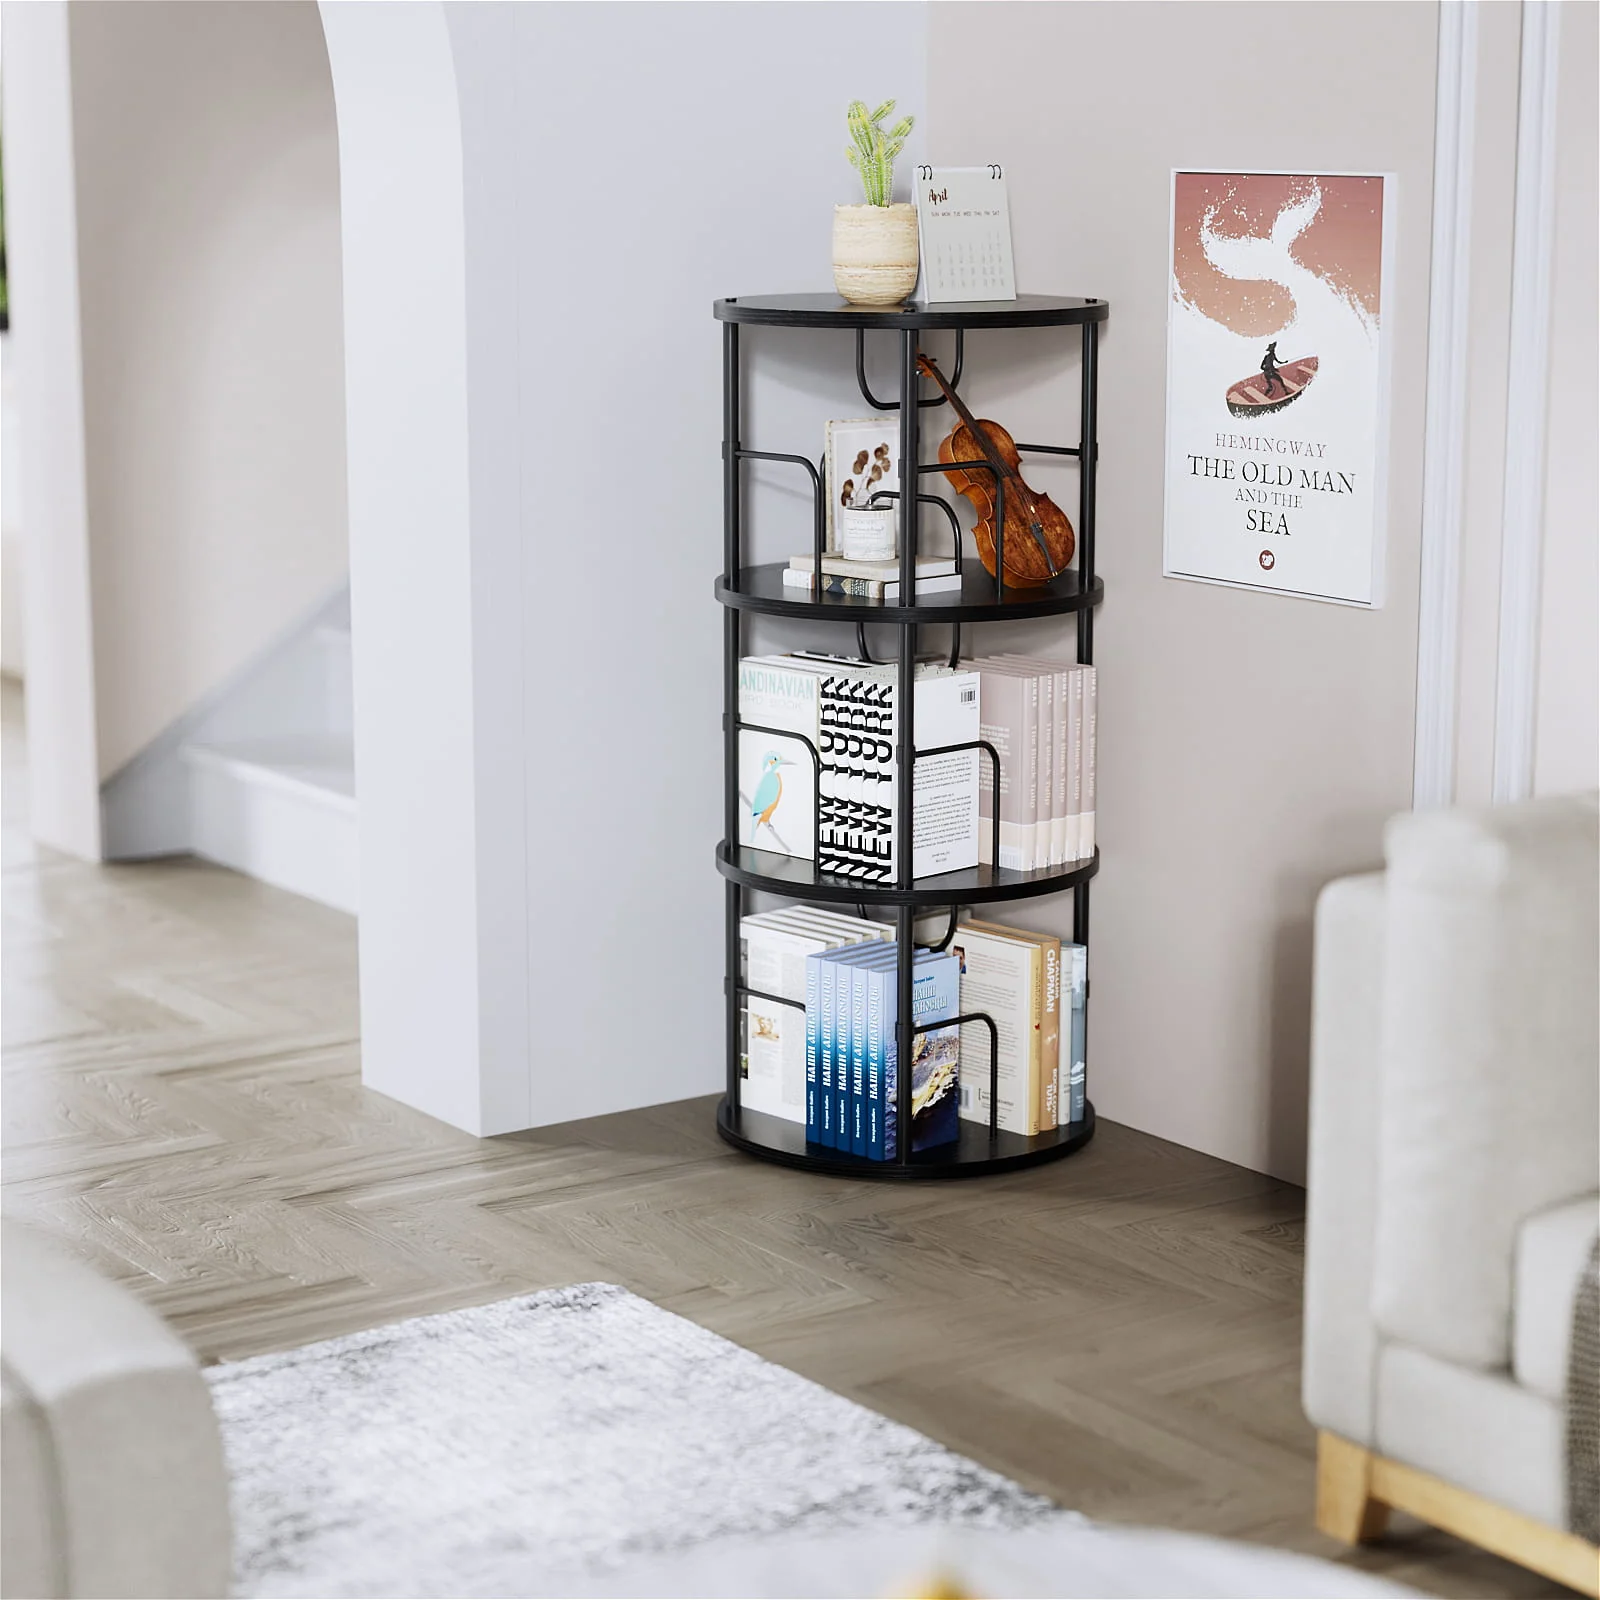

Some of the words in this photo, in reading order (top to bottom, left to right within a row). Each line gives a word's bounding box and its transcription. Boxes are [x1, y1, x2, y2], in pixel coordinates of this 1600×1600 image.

[928, 187, 948, 206] April
[1216, 433, 1327, 458] HEMINGWAY
[1187, 454, 1236, 480] THE
[1242, 461, 1293, 486] OLD
[1299, 468, 1356, 494] MAN
[1235, 488, 1268, 504] AND
[1270, 491, 1303, 508] THE
[1246, 508, 1291, 536] SEA
[740, 667, 814, 700] ANDINAVIAN
[820, 676, 834, 772] YORK
[834, 678, 848, 775] YORK
[849, 680, 863, 778] YORK
[863, 684, 878, 781] YORK
[877, 686, 892, 784] YORK
[820, 794, 834, 870] NEW
[834, 796, 848, 874] NEW
[849, 799, 863, 876] NEW
[863, 801, 878, 880] NEW
[877, 804, 892, 883] NEW
[1046, 949, 1056, 1013] CHAPMAN
[807, 1046, 815, 1082] НАШИ
[823, 1050, 831, 1087] НАШИ
[838, 1054, 846, 1091] НАШИ
[854, 1058, 862, 1095] НАШИ
[870, 1062, 878, 1100] НАШИ
